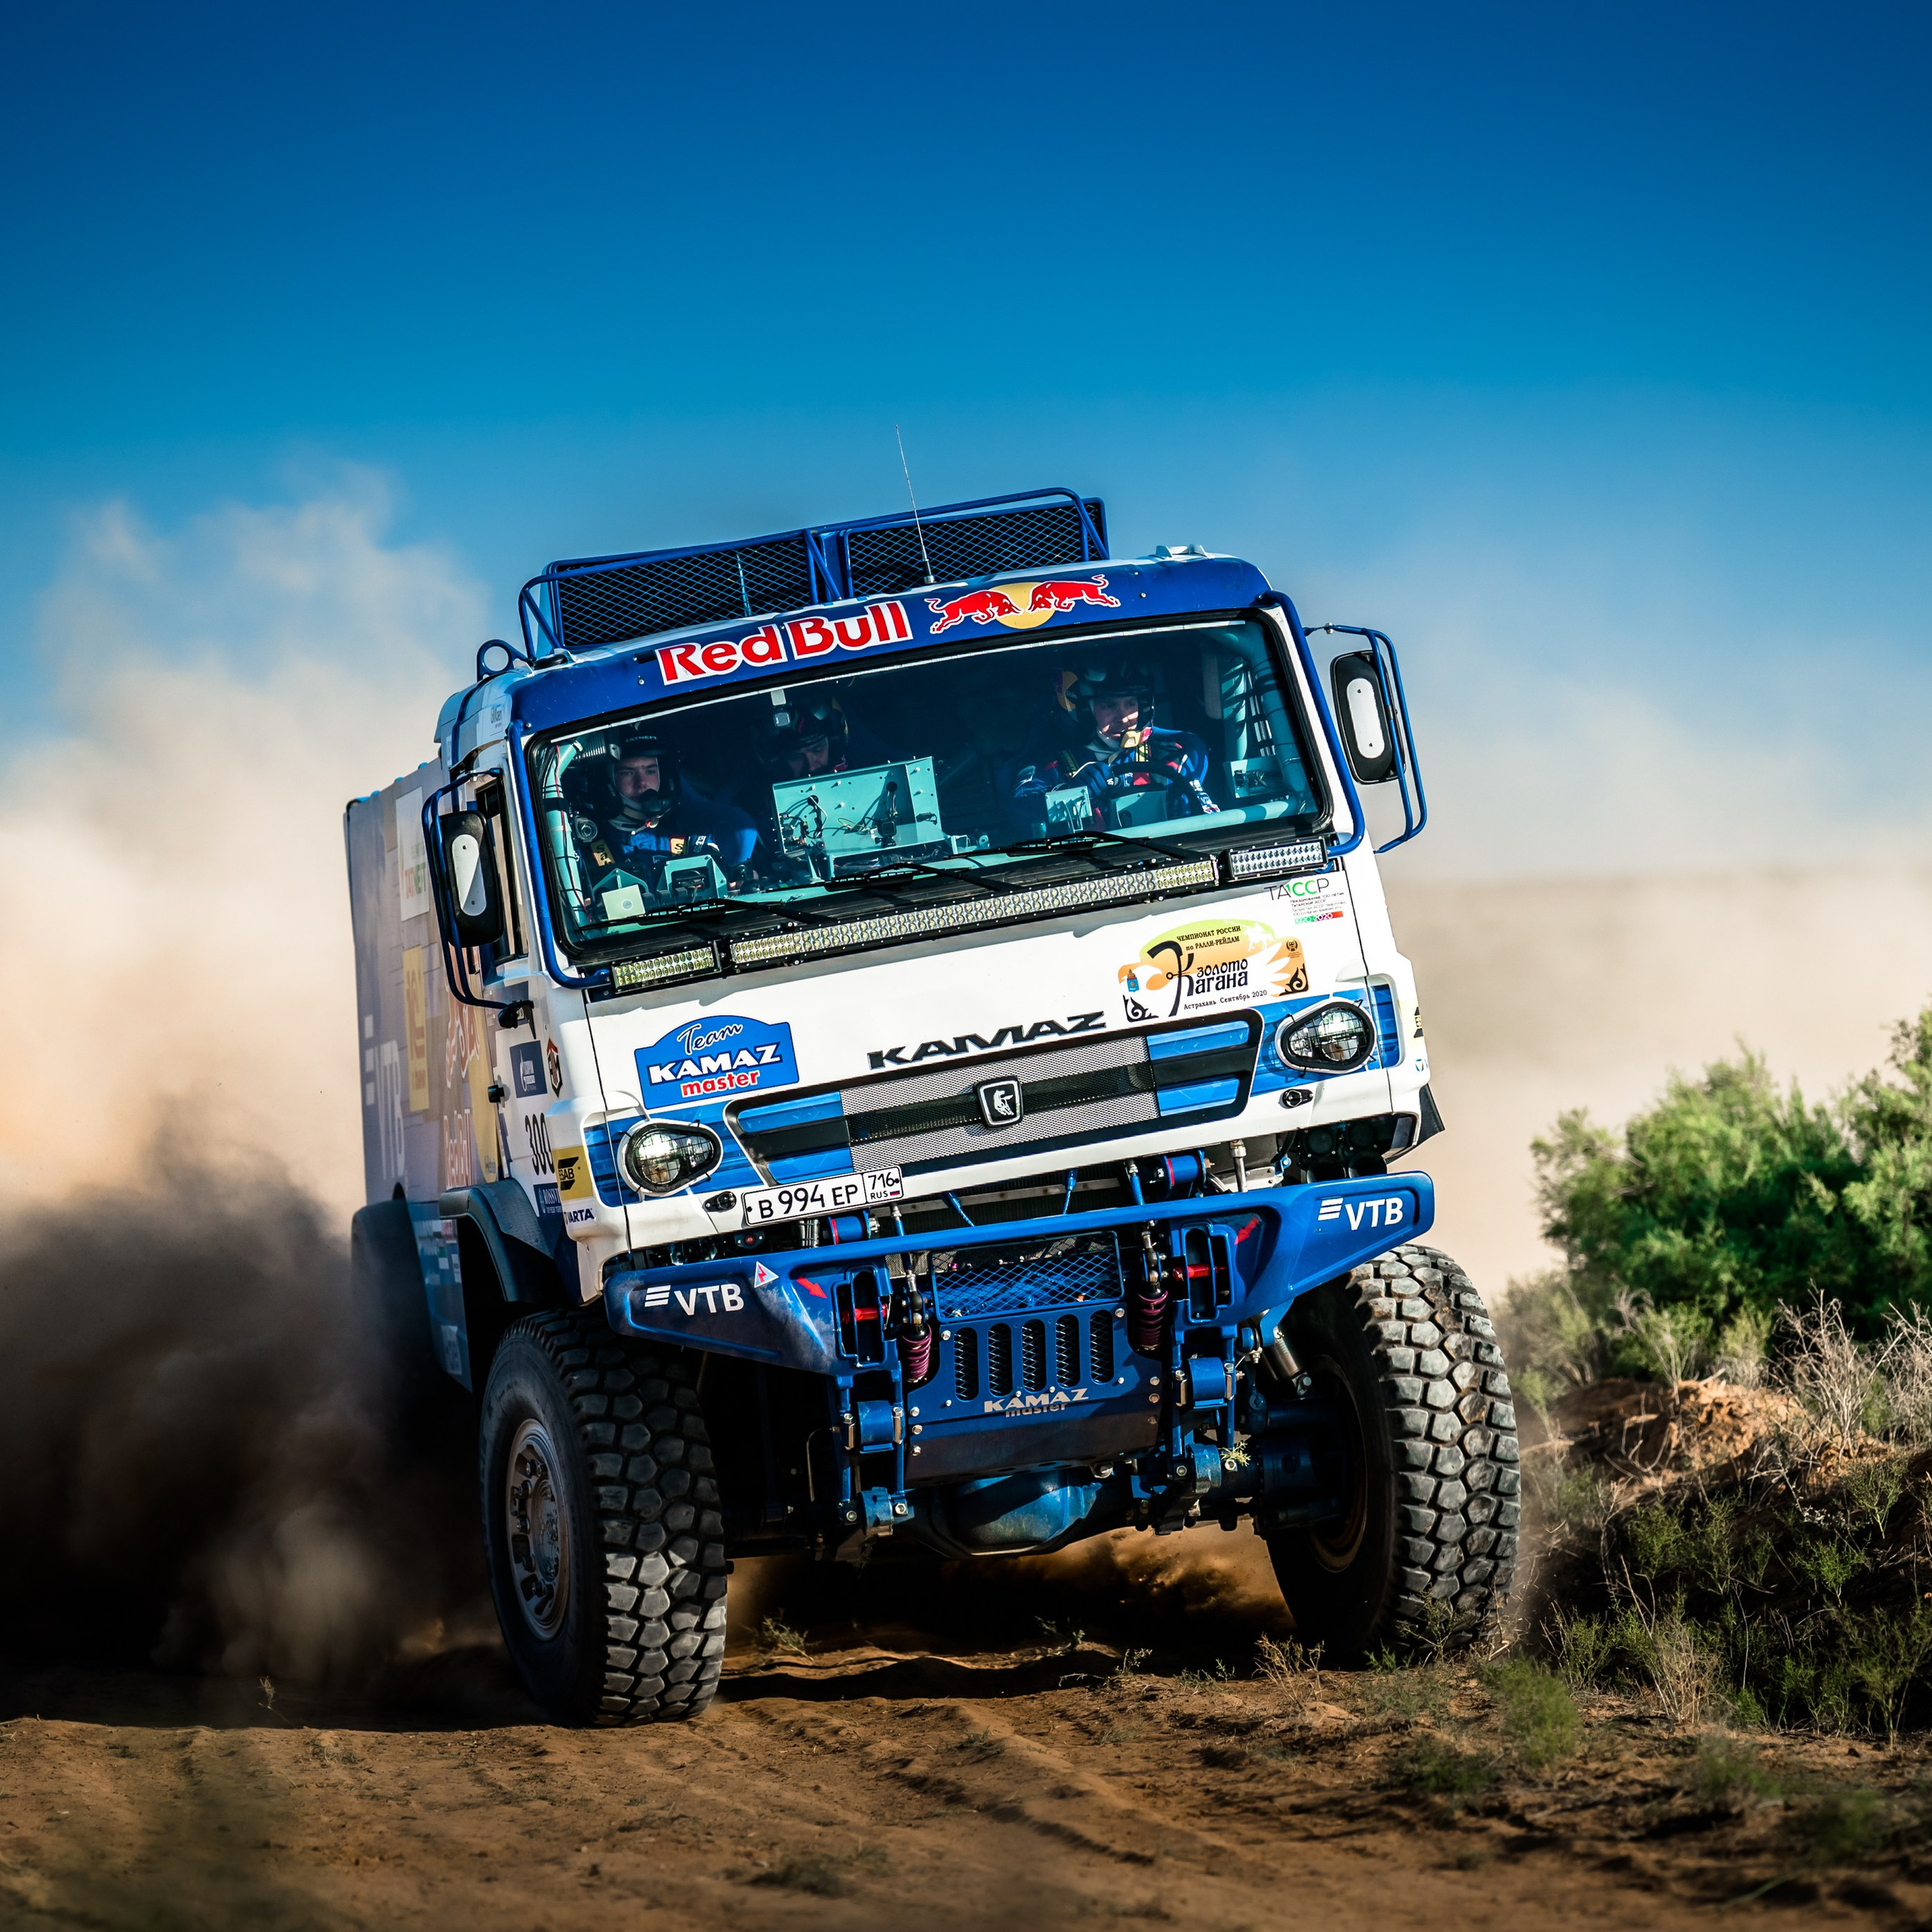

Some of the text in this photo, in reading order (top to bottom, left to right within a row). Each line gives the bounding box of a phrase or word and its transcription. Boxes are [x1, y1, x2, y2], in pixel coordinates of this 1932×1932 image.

[657, 602, 912, 684] Red Bull
[1177, 925, 1241, 942] ЧЕМПИОНАТ РОССИИ
[1183, 989, 1267, 1011] Астрахань Сентябрь 2020
[678, 1020, 744, 1056] Team
[867, 1011, 1107, 1071] KAMAZ
[648, 1043, 781, 1086] KAMAZ
[681, 1069, 760, 1097] master
[525, 1112, 555, 1176] 300
[777, 1189, 827, 1216] 994
[868, 1171, 896, 1191] 716
[869, 1190, 890, 1200] RUS
[1345, 1197, 1404, 1231] VTB
[674, 1283, 744, 1315] VTB
[984, 1388, 1089, 1413] KAMAZ
[1005, 1401, 1068, 1418] master
